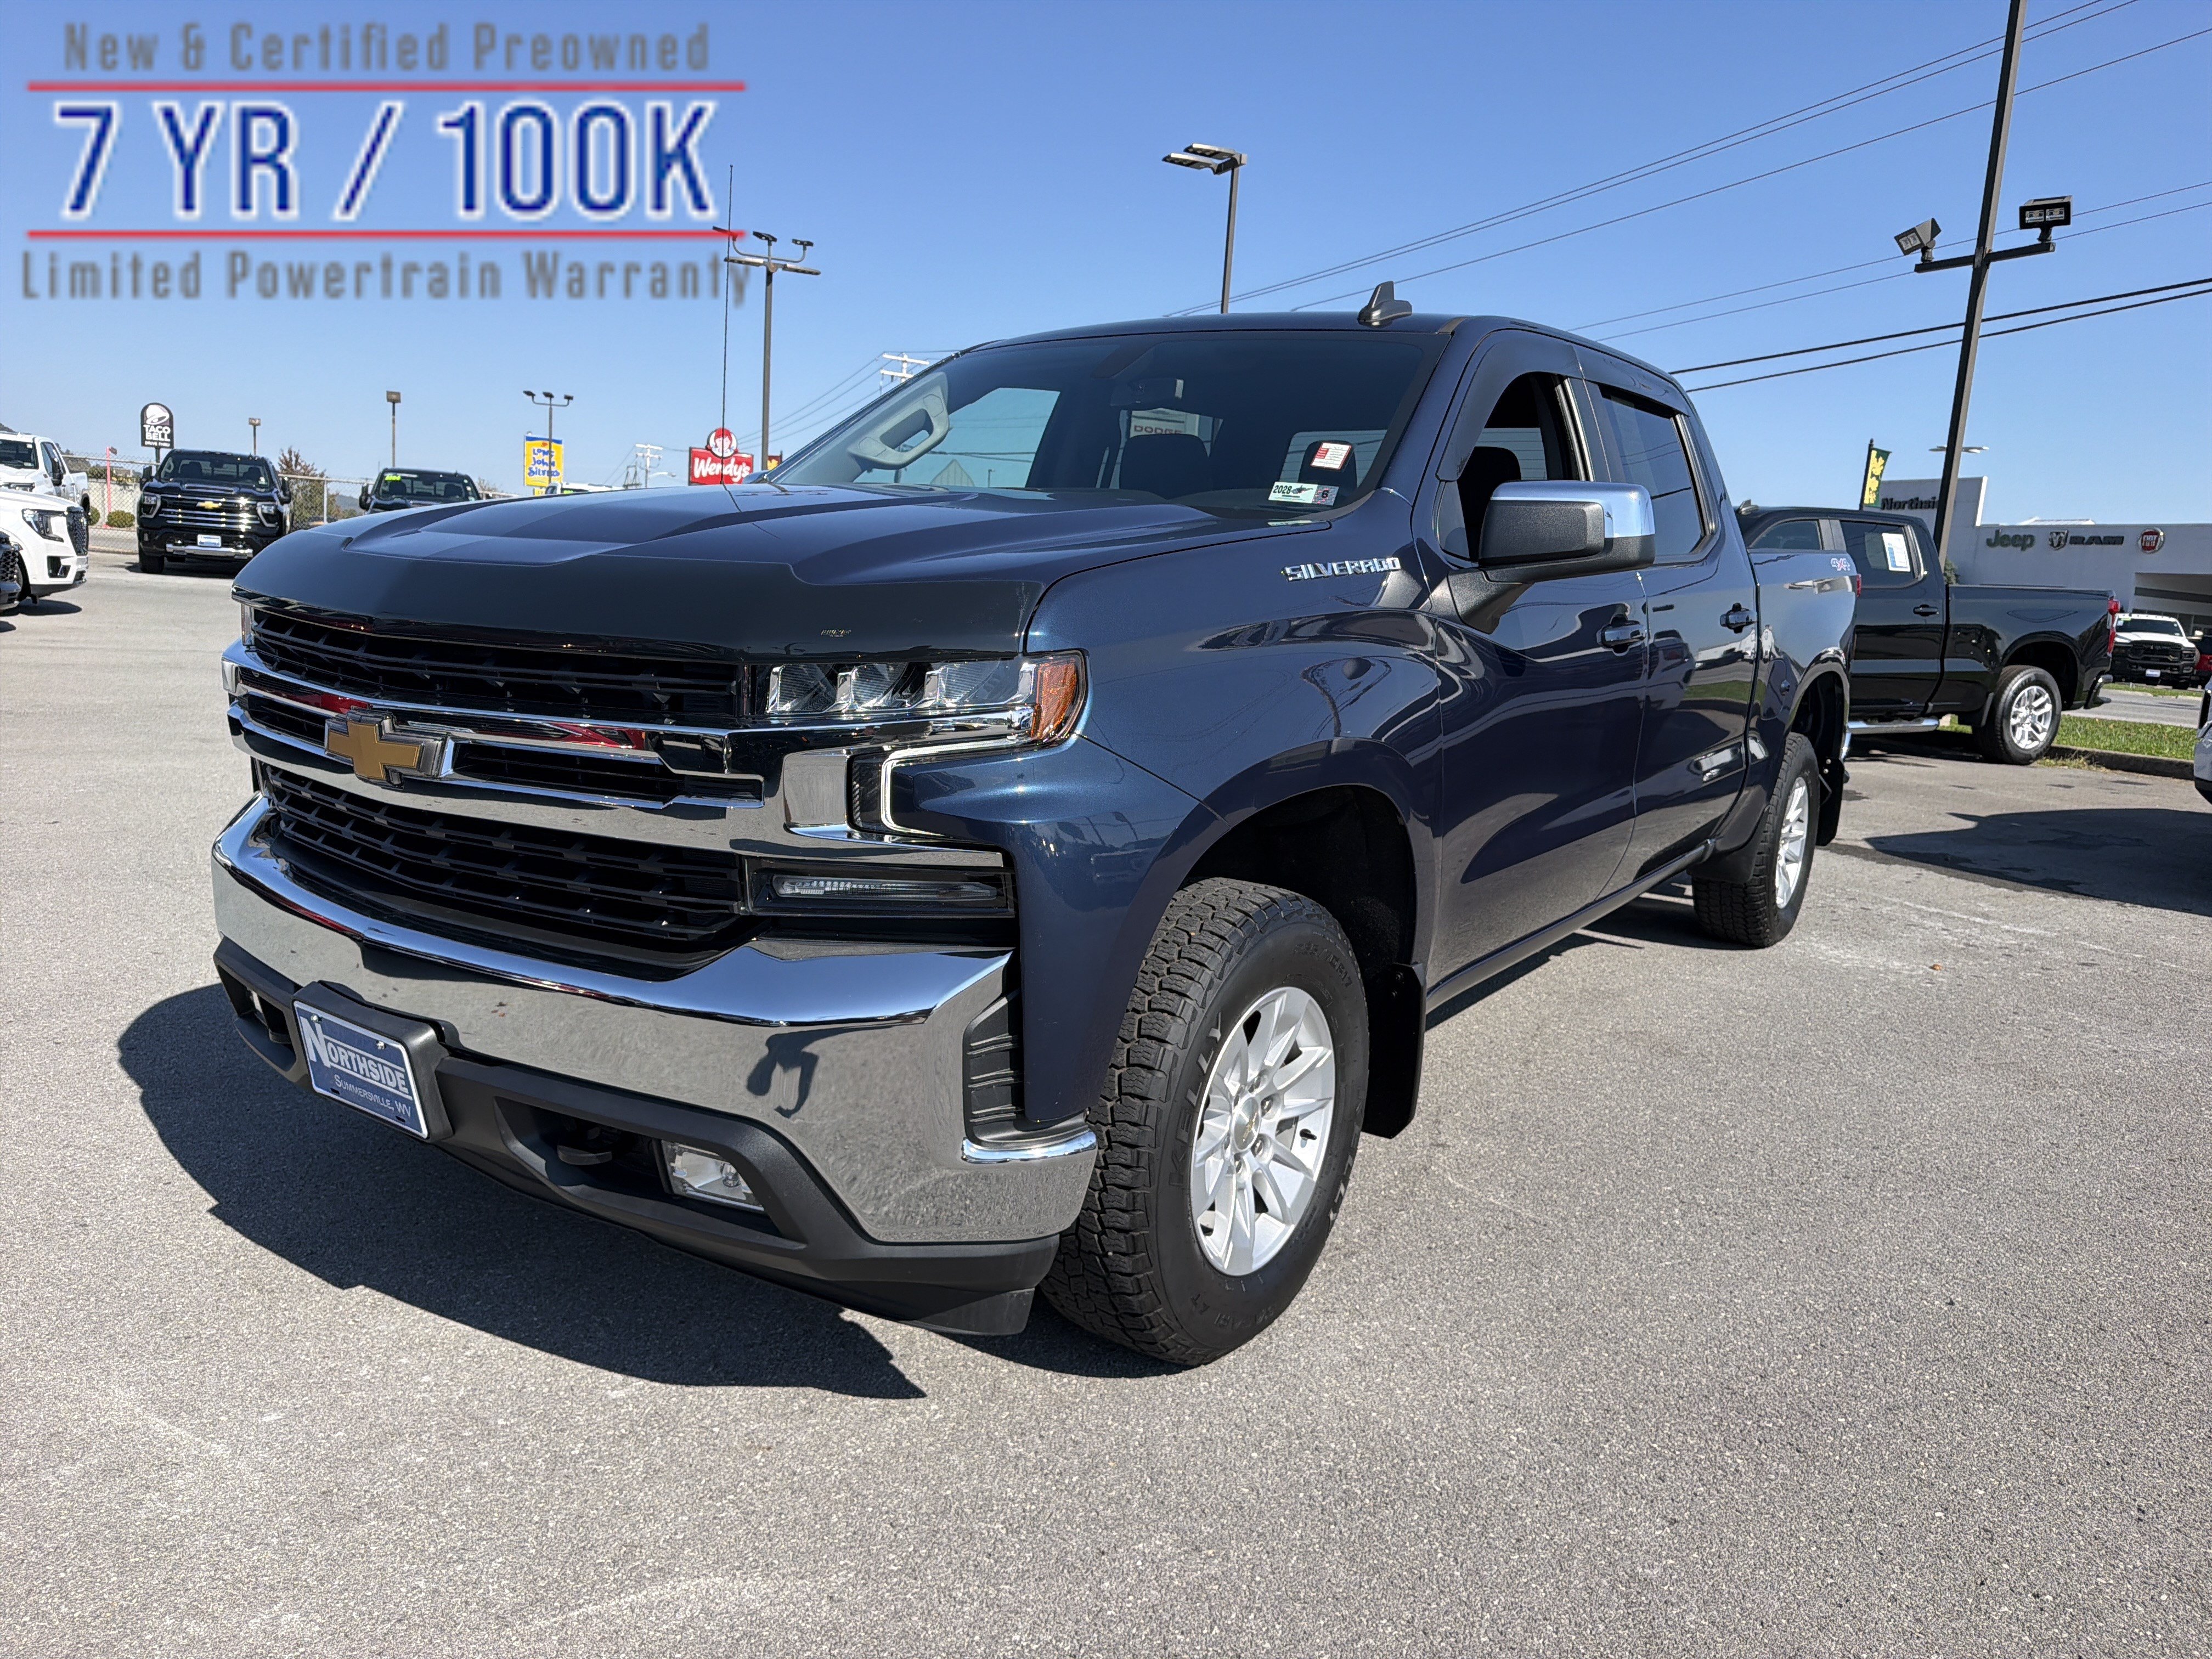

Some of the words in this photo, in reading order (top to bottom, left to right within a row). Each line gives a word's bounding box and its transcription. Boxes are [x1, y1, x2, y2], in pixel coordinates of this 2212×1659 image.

[143, 425, 171, 434] TACO
[146, 432, 171, 442] BELL
[693, 456, 751, 483] Wendy's
[1273, 484, 1293, 494] 2028
[1321, 489, 1330, 499] 6
[1882, 496, 1939, 510] Northsi
[1986, 529, 2036, 551] Jeep
[2069, 535, 2125, 546] RAM
[1283, 557, 1401, 582] SILVERADO
[300, 1015, 409, 1094] NORTHSIDE
[334, 1074, 394, 1112] SUMMERSVILLE,
[394, 1102, 412, 1118] WV
[1169, 1011, 1222, 1187] KELLY
